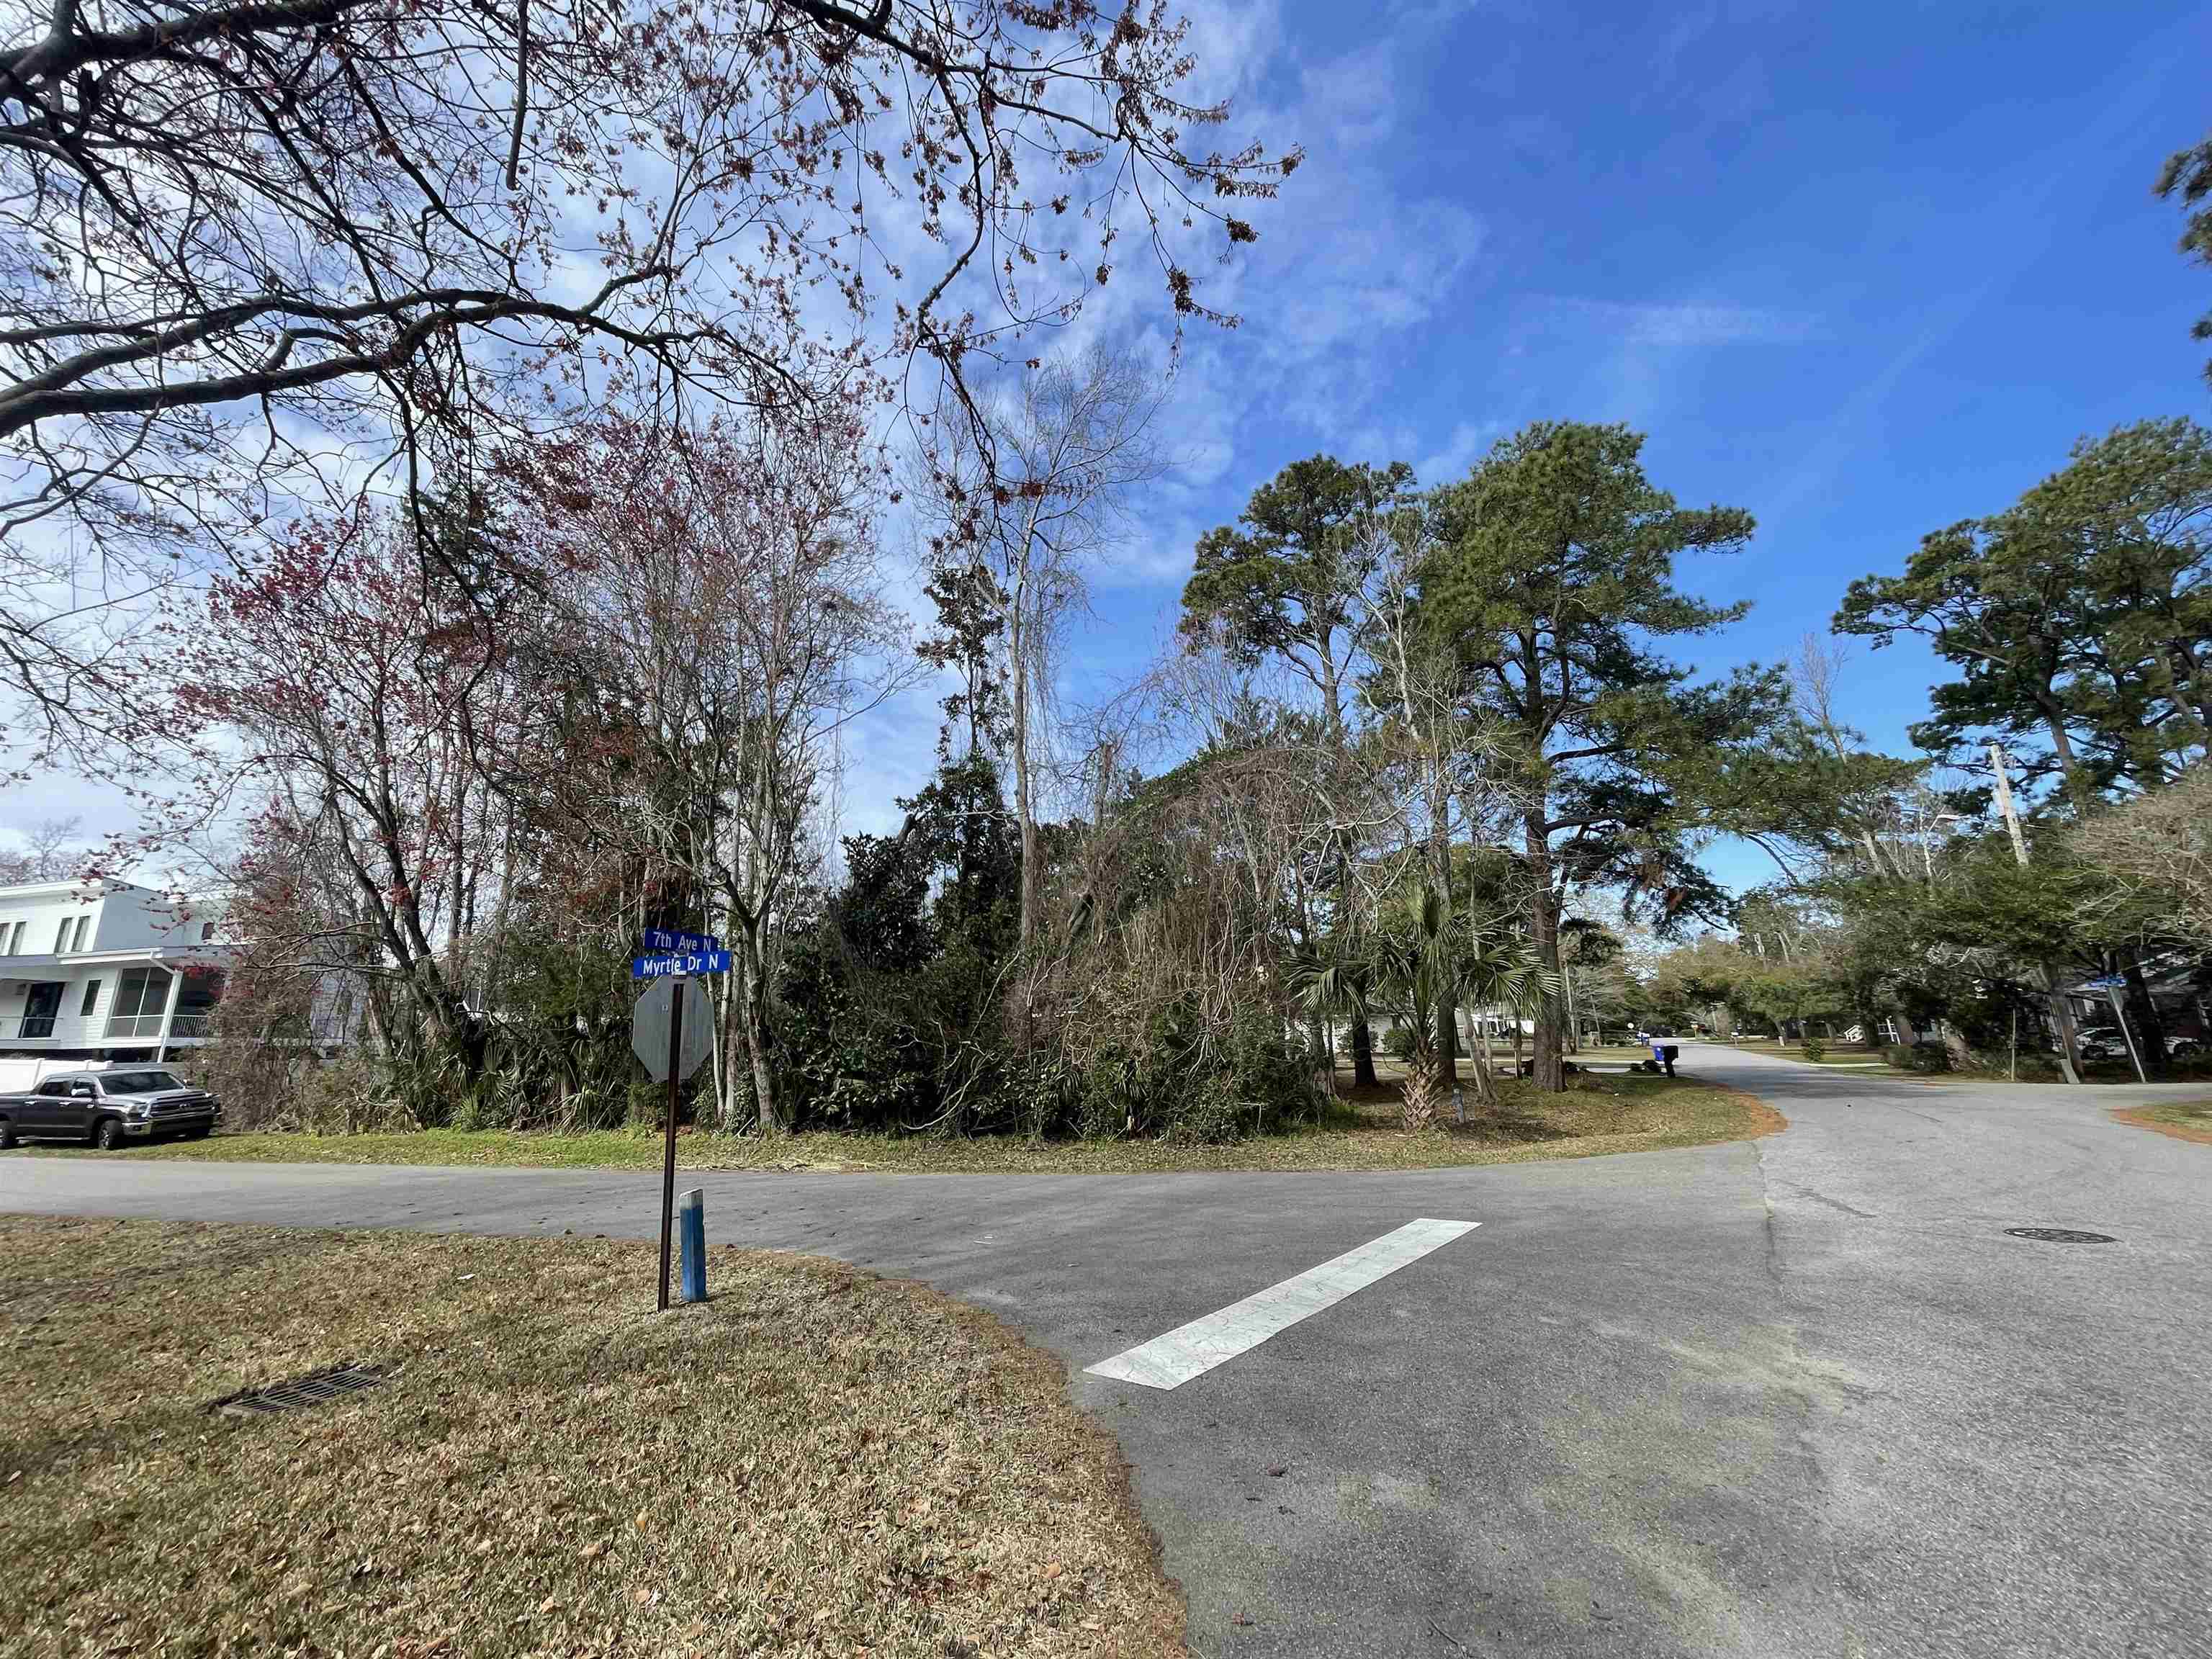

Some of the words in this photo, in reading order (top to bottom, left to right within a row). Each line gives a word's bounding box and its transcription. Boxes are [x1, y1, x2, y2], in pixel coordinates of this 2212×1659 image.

[653, 932, 672, 948] 7th
[678, 935, 698, 950] Ave
[703, 938, 711, 952] N
[643, 958, 681, 976] Myrtle
[688, 956, 702, 971] Dr
[709, 954, 719, 969] N
